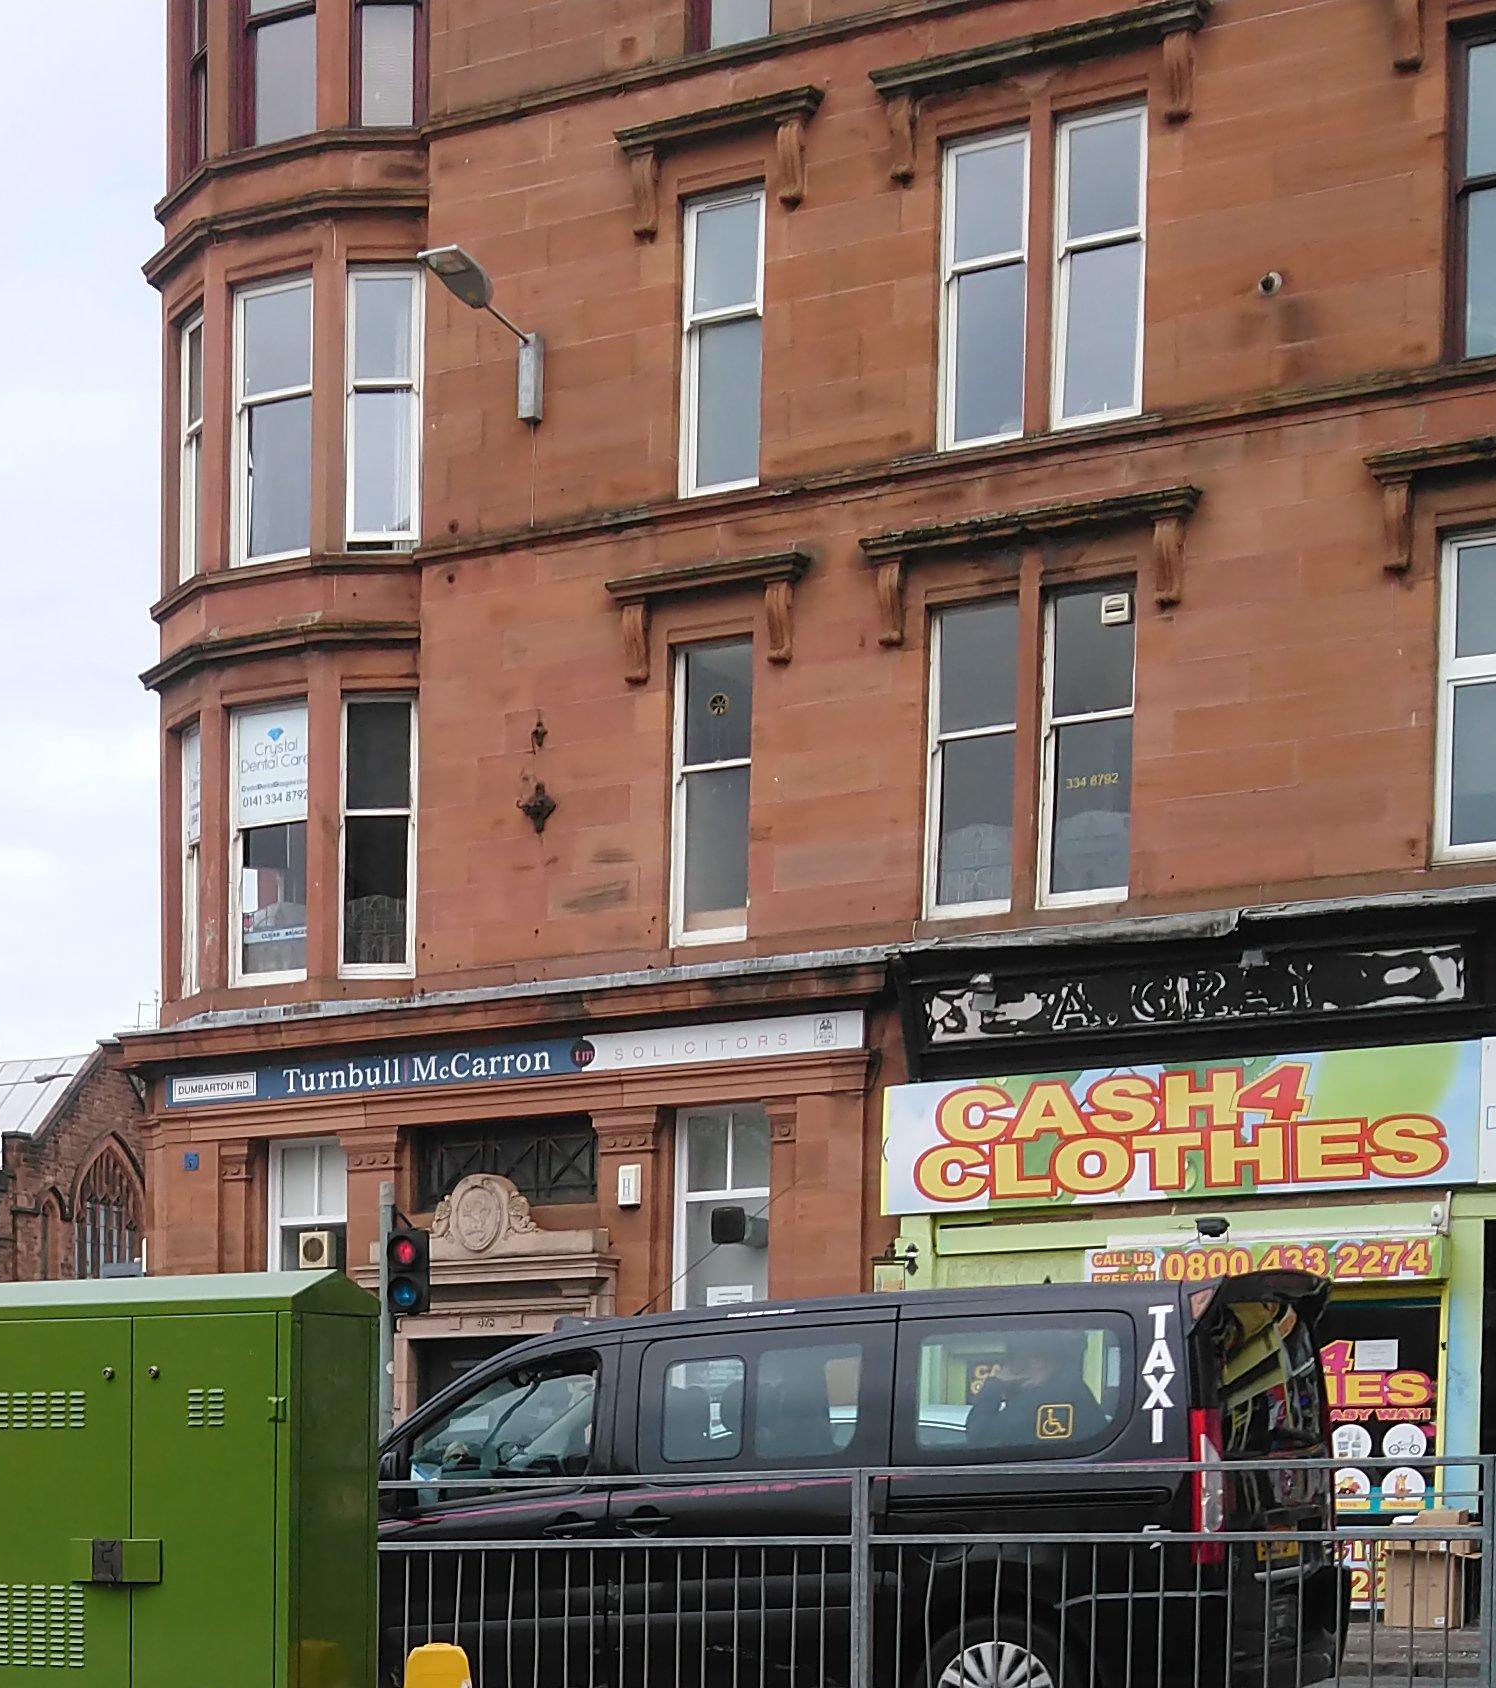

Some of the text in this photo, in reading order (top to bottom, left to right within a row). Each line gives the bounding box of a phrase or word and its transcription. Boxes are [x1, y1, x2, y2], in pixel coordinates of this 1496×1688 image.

[614, 1033, 789, 1060] SOLICITORS
[178, 1082, 233, 1095] DUMBARTON
[283, 1051, 551, 1093] Turnbull McCarron
[912, 1112, 1449, 1202] CLOTHES
[1092, 1252, 1155, 1267] CALL US
[1165, 1248, 1250, 1282] 0800
[1335, 1241, 1430, 1276] 2274
[1320, 1340, 1354, 1373] 4
[1141, 1304, 1174, 1443] TAXI
[1330, 1408, 1374, 1420] ASY
